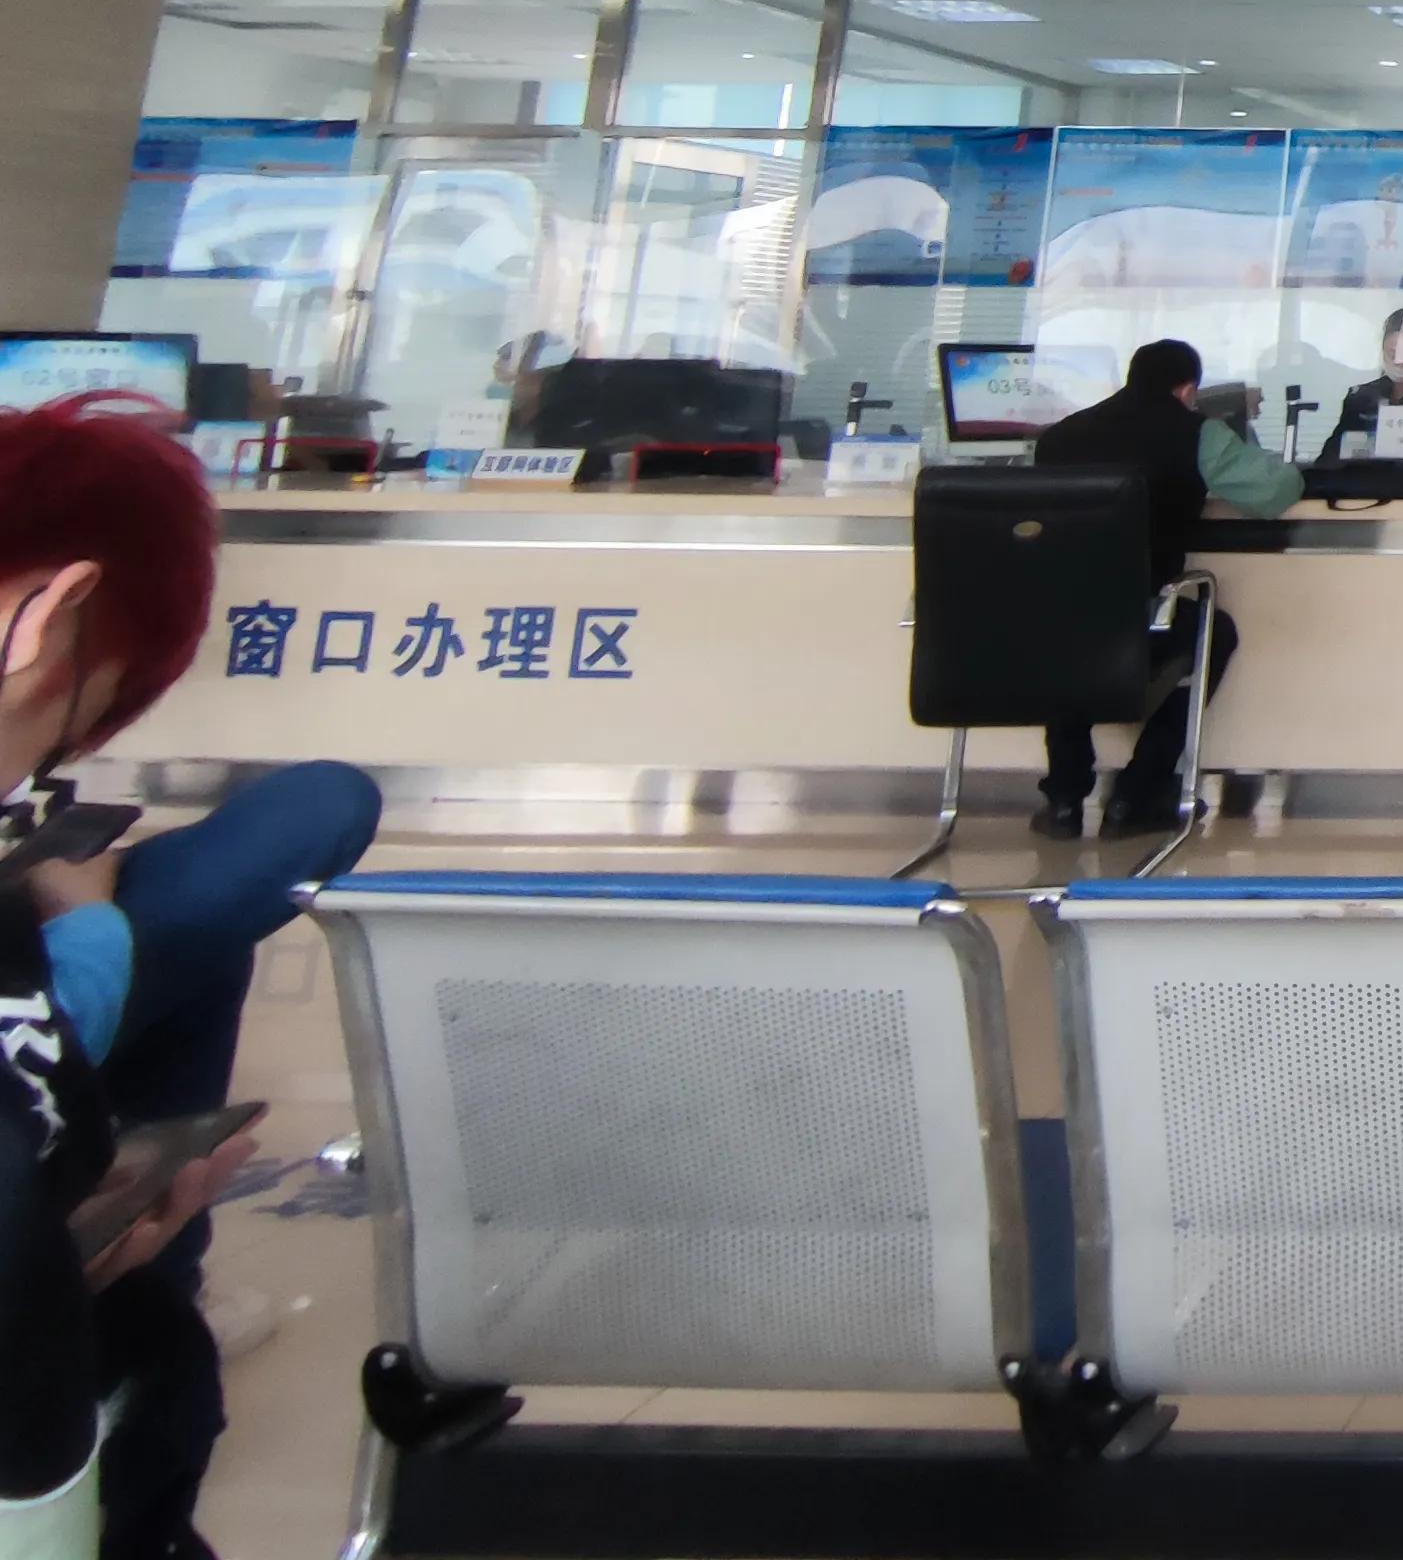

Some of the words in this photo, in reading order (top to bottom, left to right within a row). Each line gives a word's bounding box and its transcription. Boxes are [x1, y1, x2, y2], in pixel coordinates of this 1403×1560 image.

[226, 600, 638, 680] 窗口办理区
